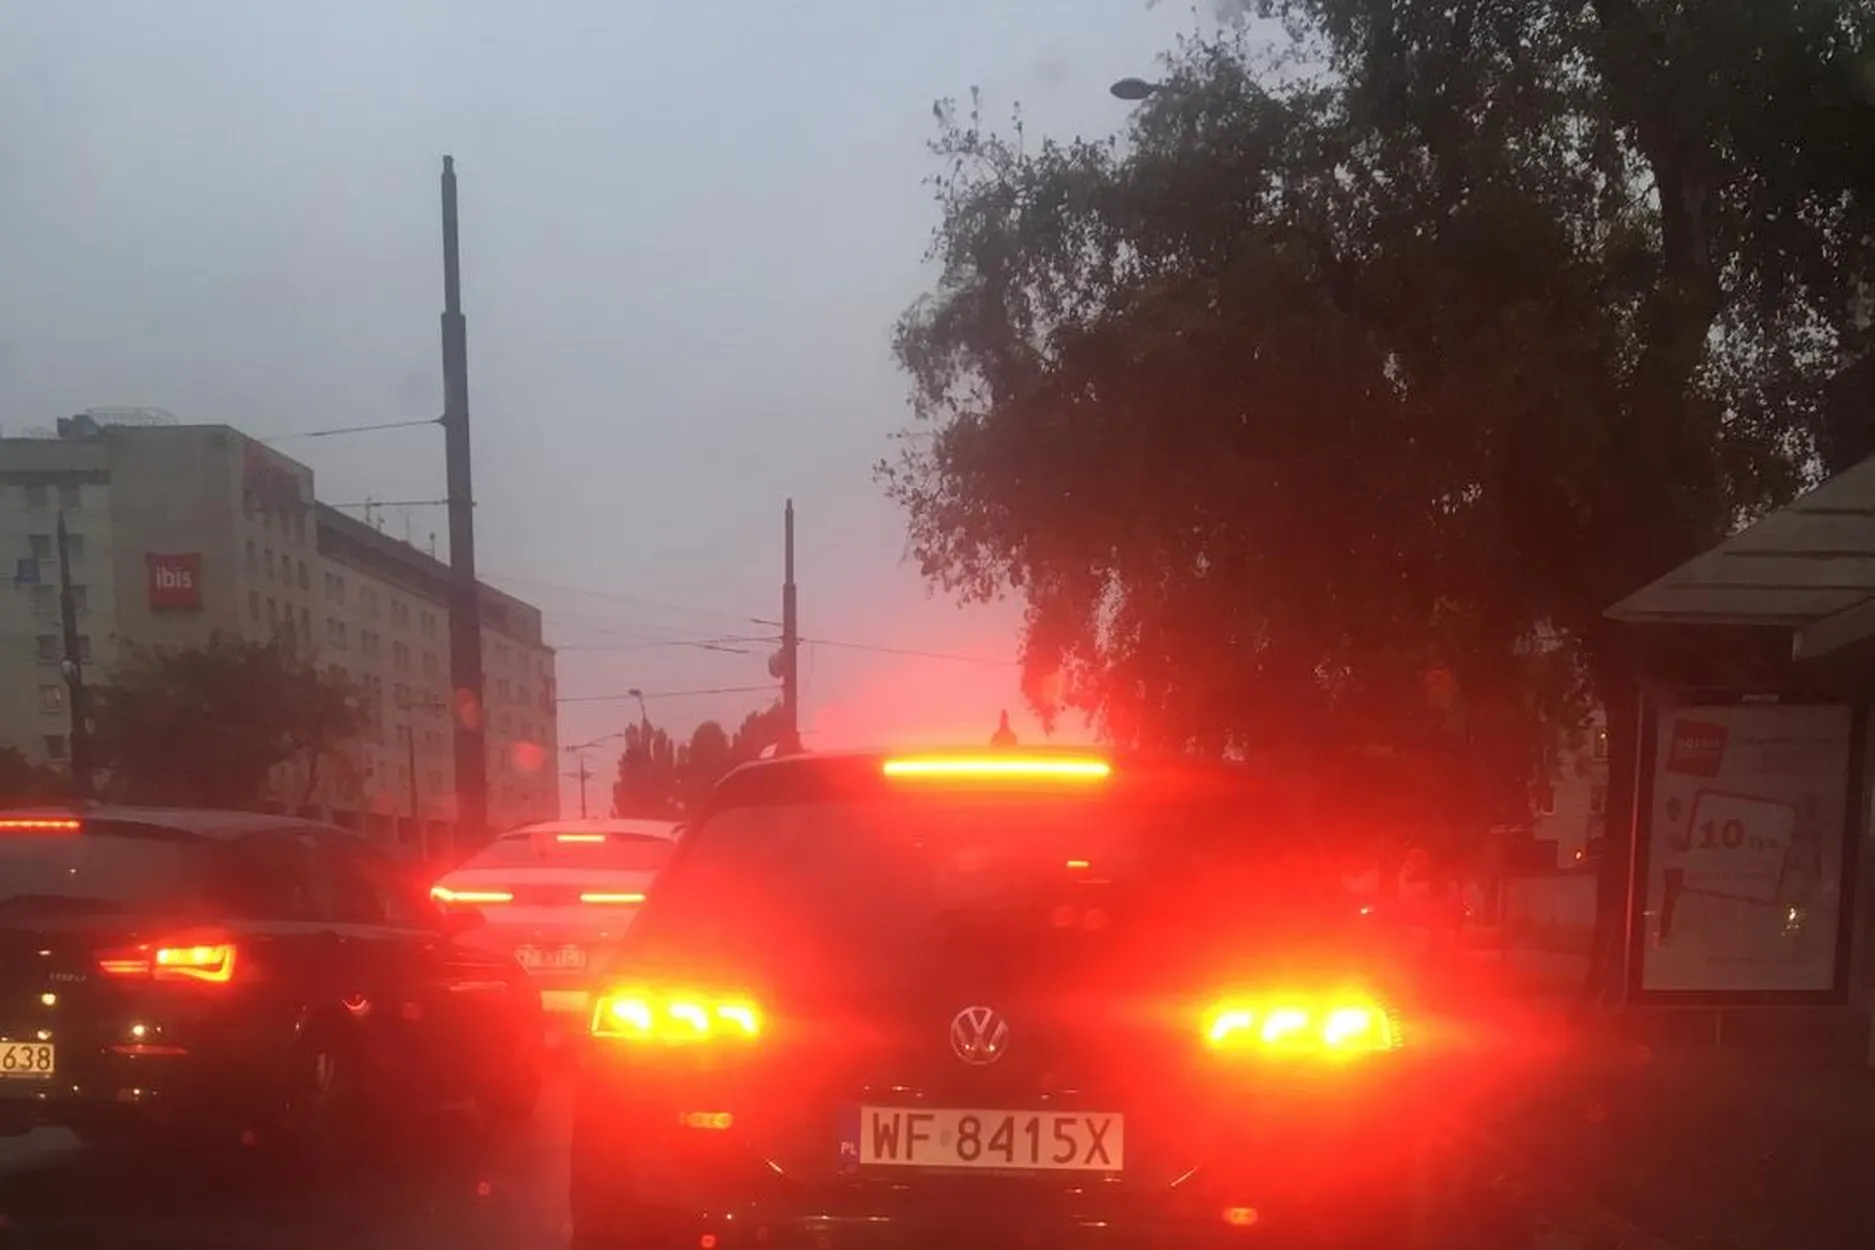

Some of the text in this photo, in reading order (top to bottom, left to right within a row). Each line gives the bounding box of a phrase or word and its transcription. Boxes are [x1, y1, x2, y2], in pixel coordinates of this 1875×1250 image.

[155, 565, 192, 590] ibis
[1699, 818, 1745, 849] 10
[2, 1046, 51, 1071] 638
[840, 1141, 858, 1156] PL
[872, 1111, 1112, 1165] WF 8415X
